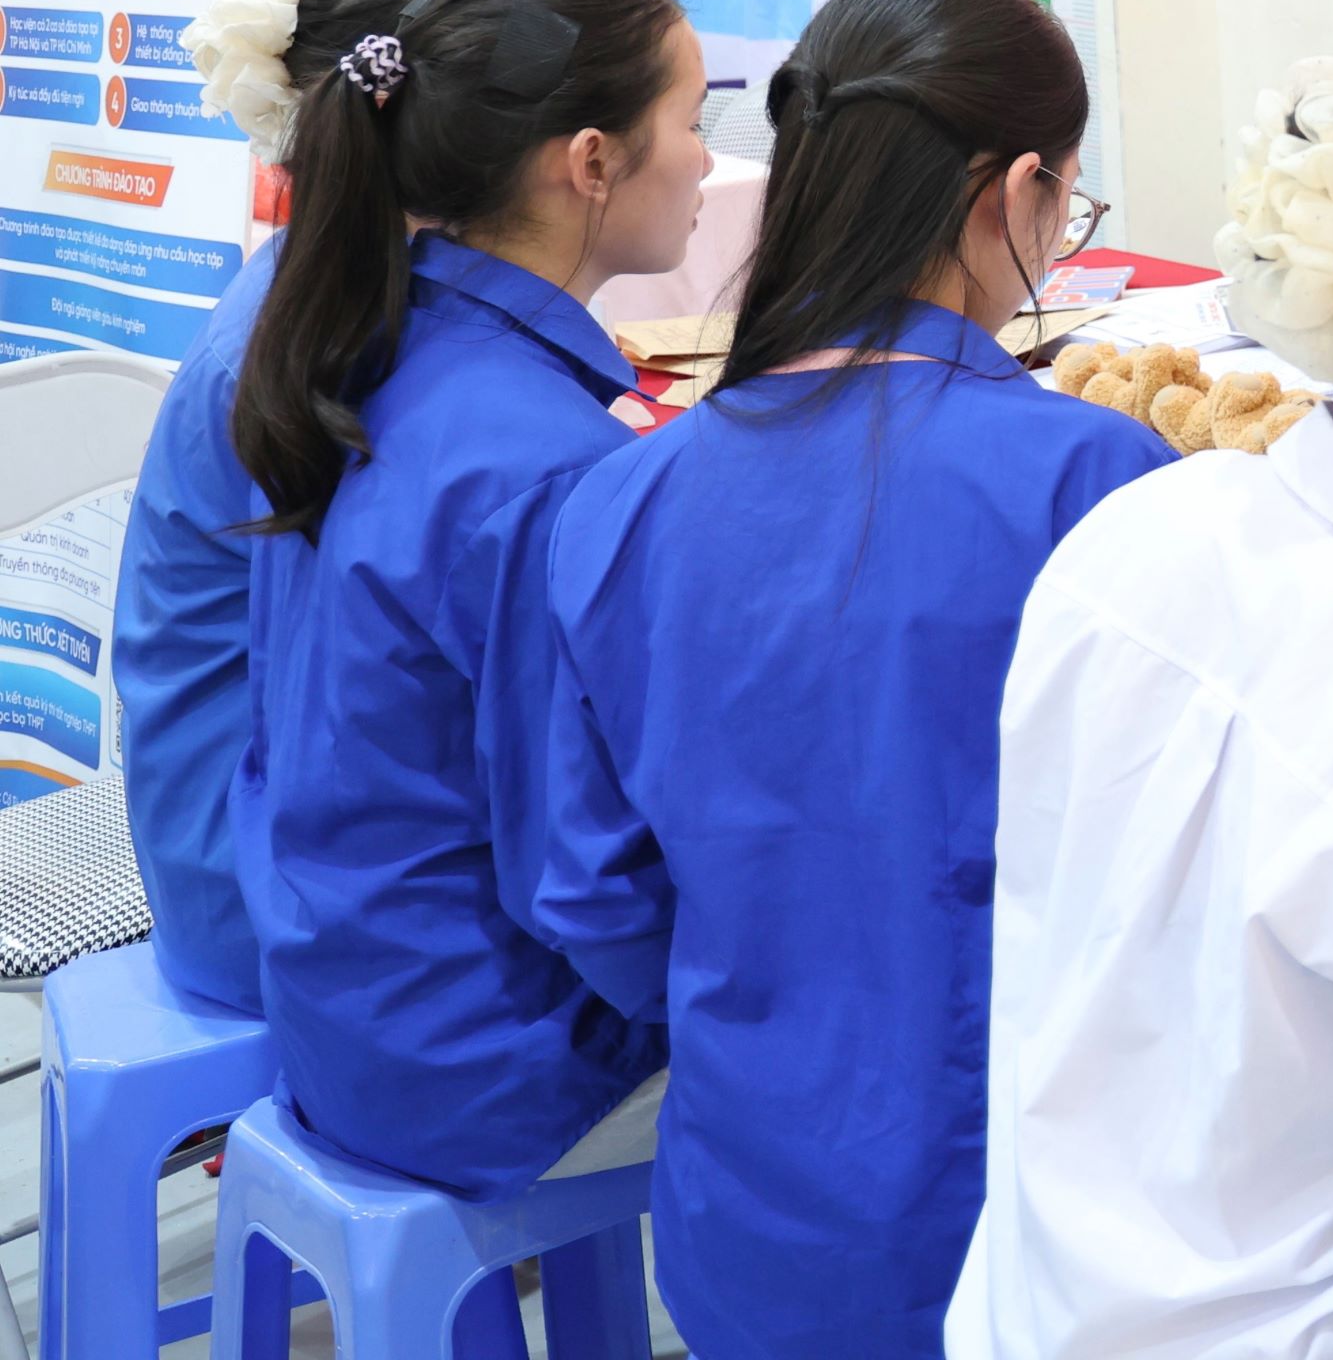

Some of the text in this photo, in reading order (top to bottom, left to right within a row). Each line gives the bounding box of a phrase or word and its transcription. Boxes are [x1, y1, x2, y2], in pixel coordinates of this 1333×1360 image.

[115, 28, 123, 49] 3
[111, 93, 119, 113] 4
[135, 175, 155, 200] TẠO
